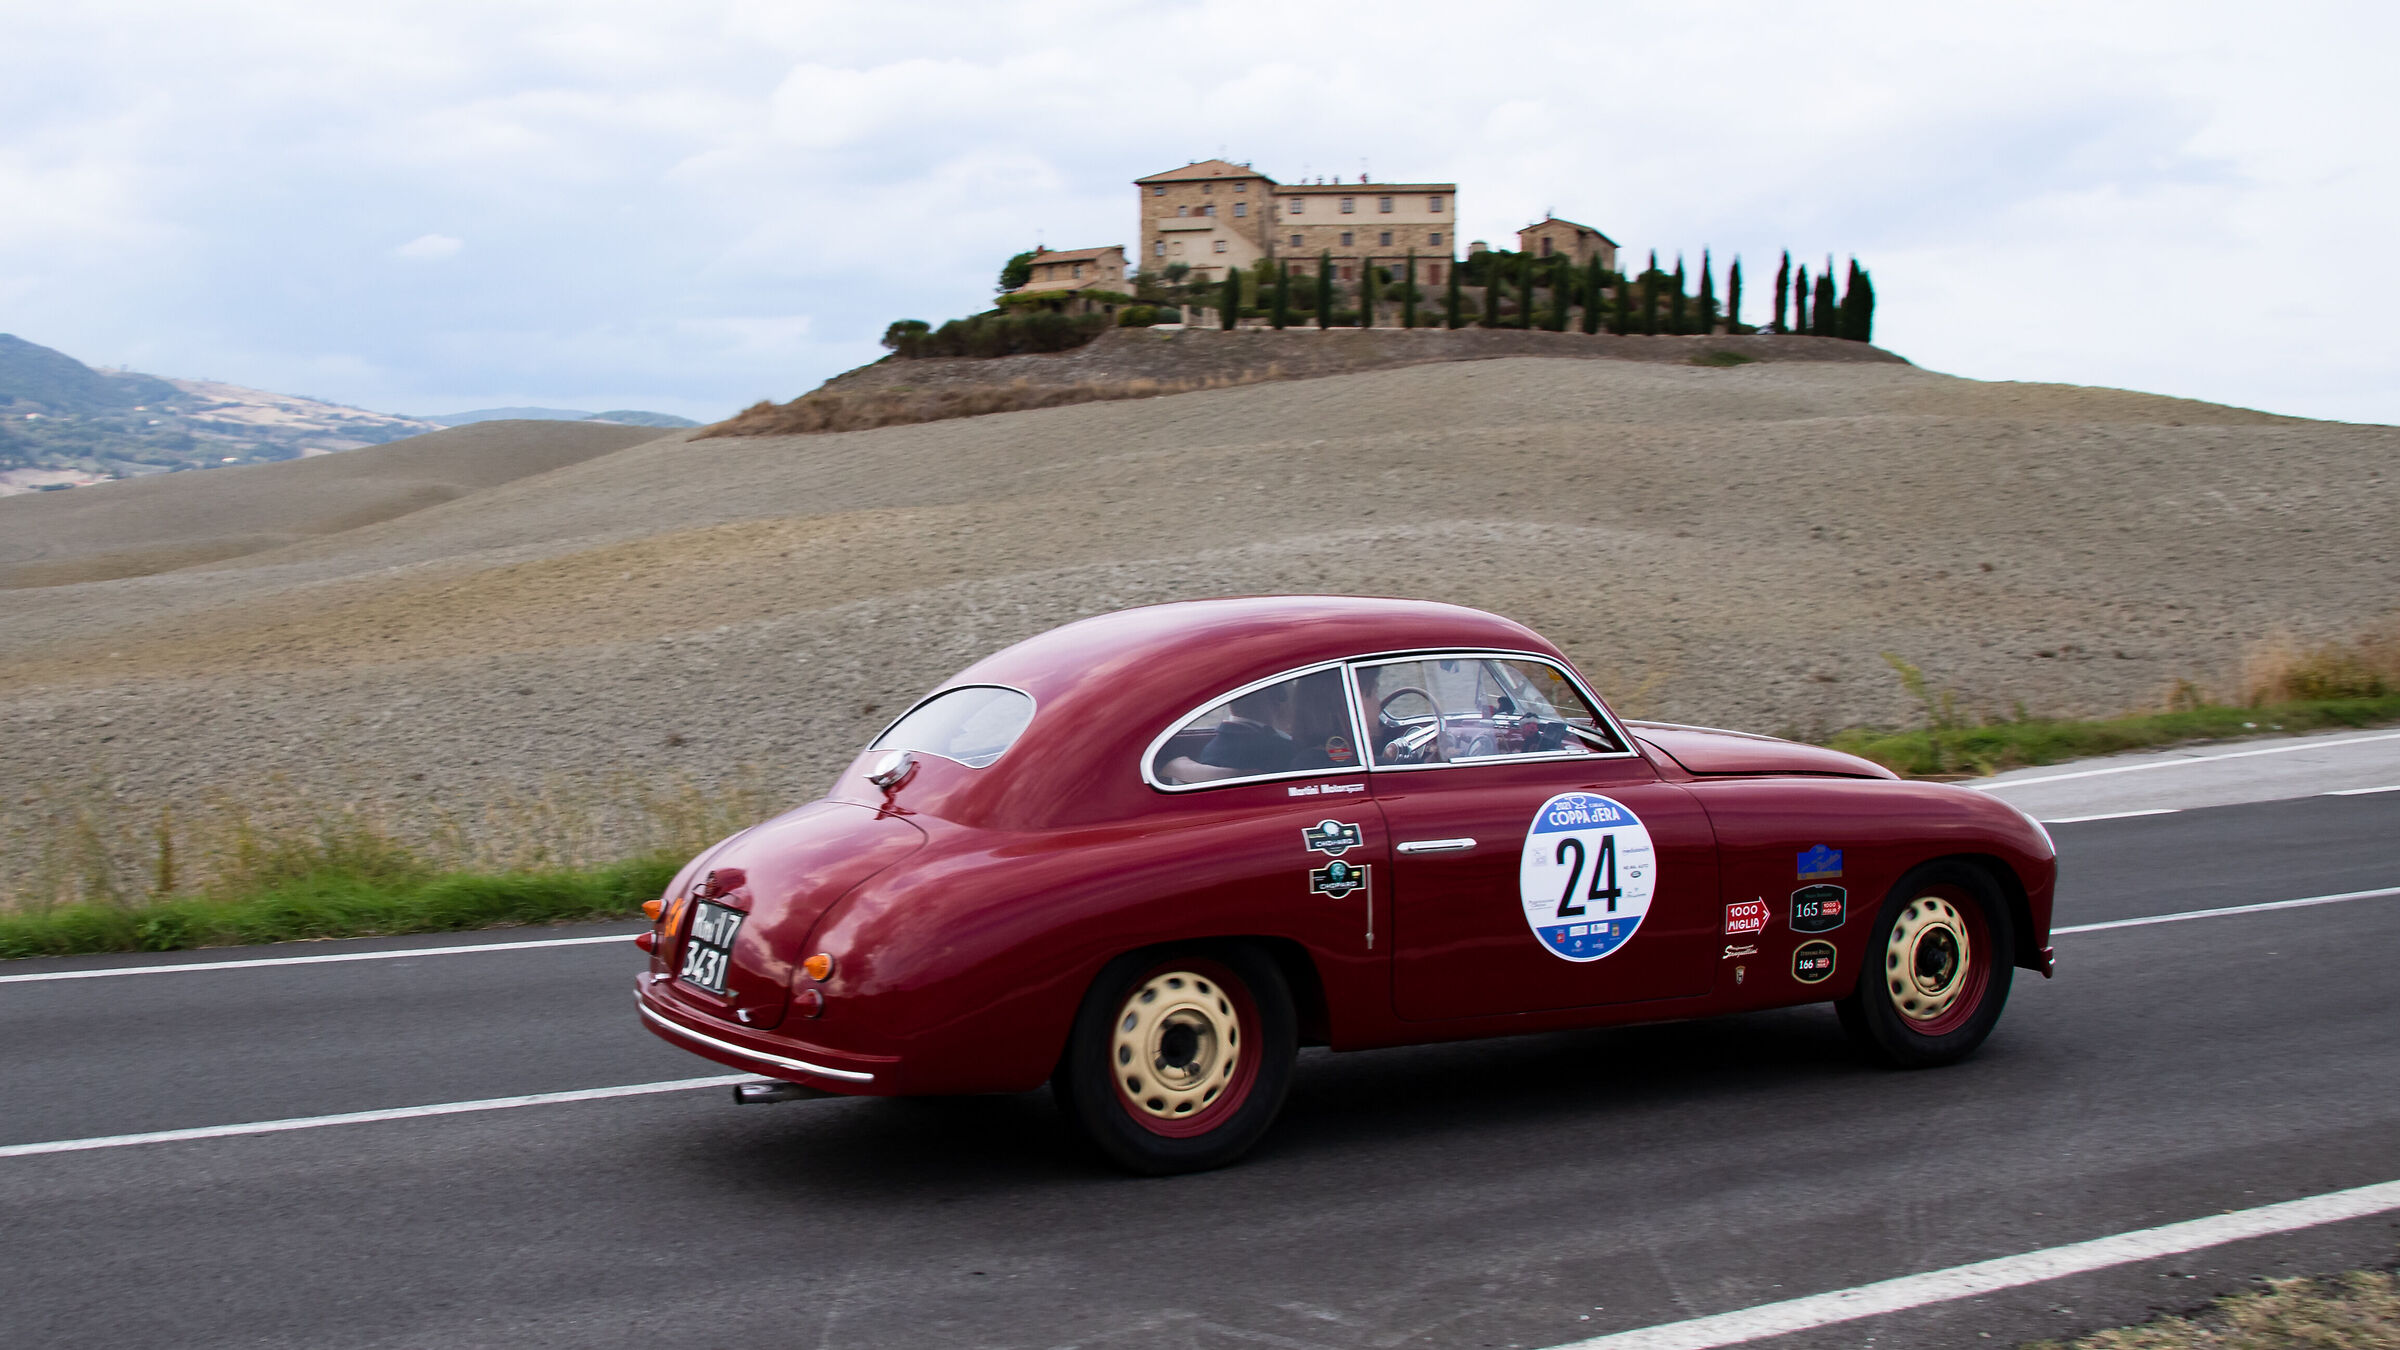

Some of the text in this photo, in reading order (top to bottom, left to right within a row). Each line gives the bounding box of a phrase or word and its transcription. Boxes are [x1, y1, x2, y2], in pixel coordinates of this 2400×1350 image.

[1549, 810, 1591, 826] COPPA
[1556, 833, 1622, 918] 24
[1730, 905, 1758, 917] 1000
[1796, 902, 1819, 918] 165
[1728, 918, 1759, 931] MIGLIA
[681, 941, 728, 990] 3431
[1799, 959, 1814, 969] 166
